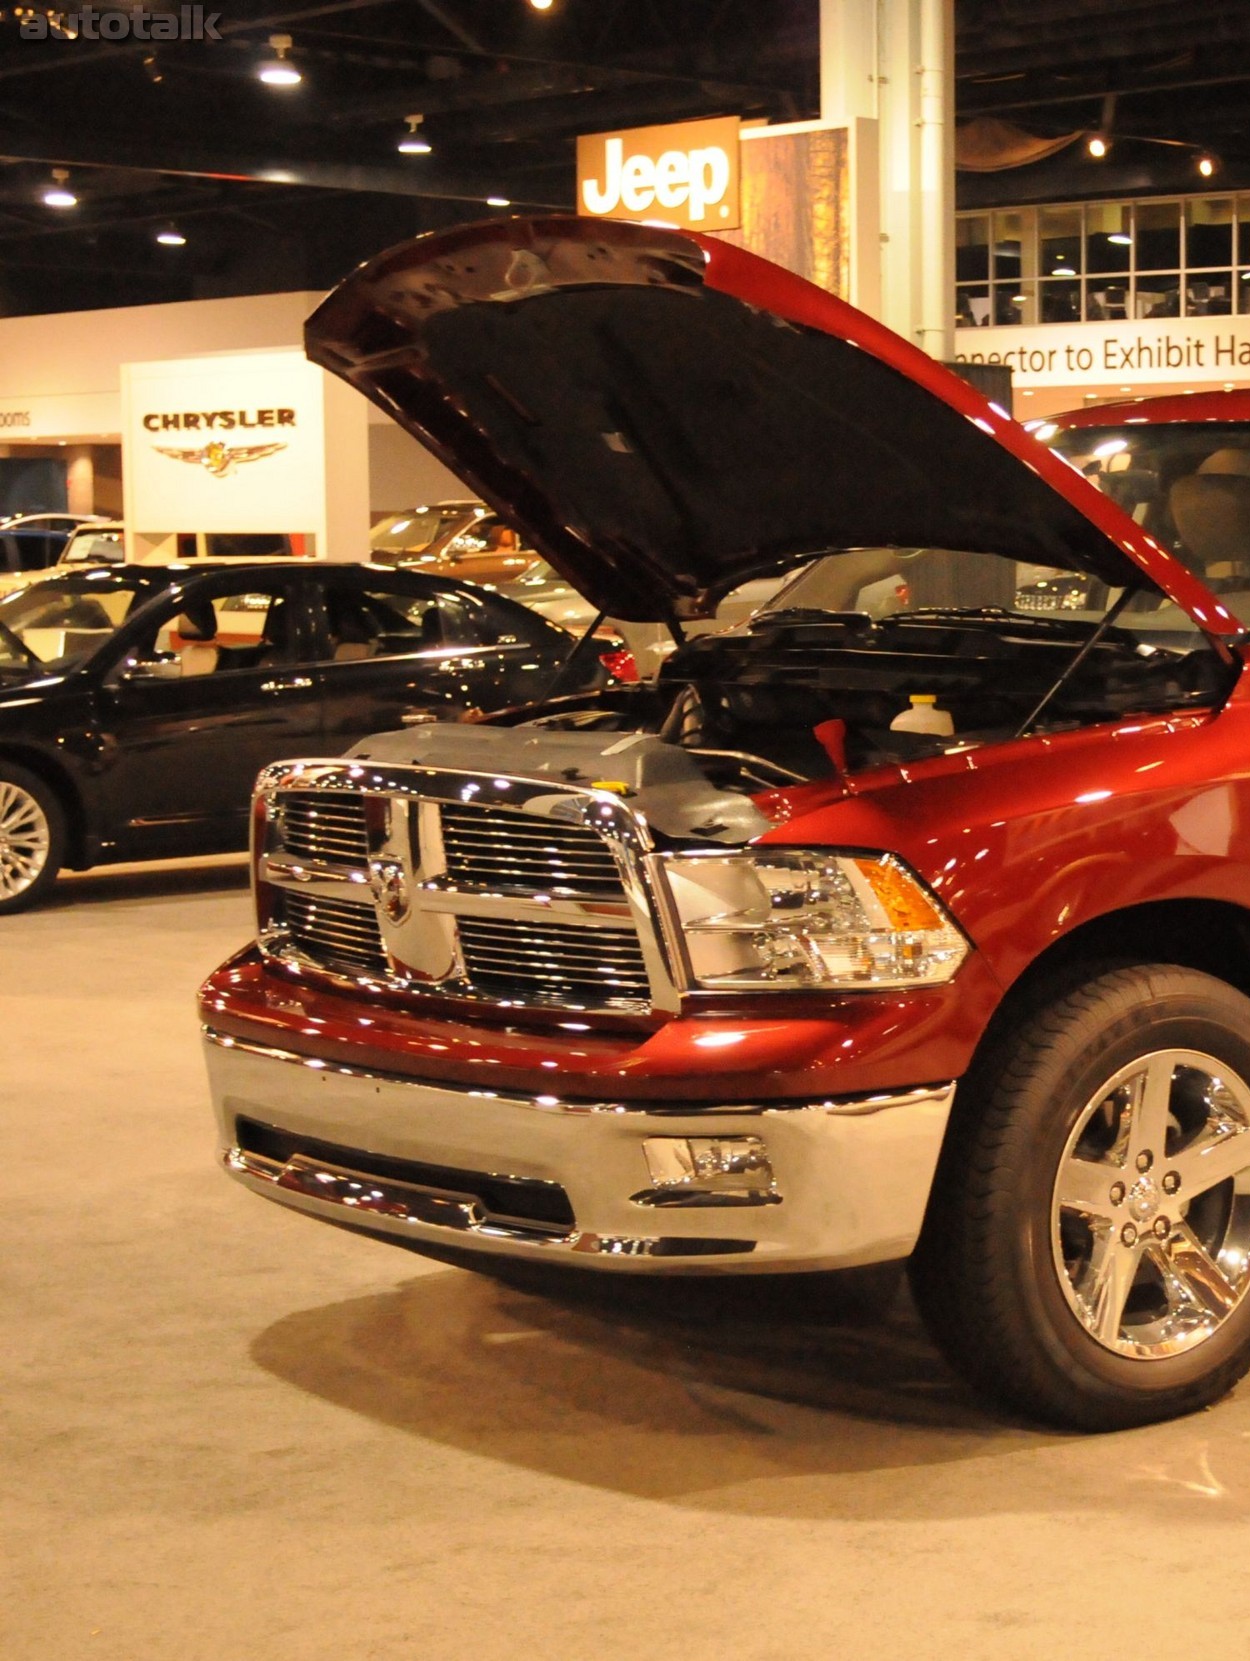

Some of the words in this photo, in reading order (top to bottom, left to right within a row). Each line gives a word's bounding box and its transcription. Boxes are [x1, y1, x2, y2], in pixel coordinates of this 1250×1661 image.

[582, 138, 730, 221] Jeep
[1065, 344, 1093, 372] to
[1104, 336, 1204, 369] Exhibit
[143, 408, 296, 432] CHRYSLER
